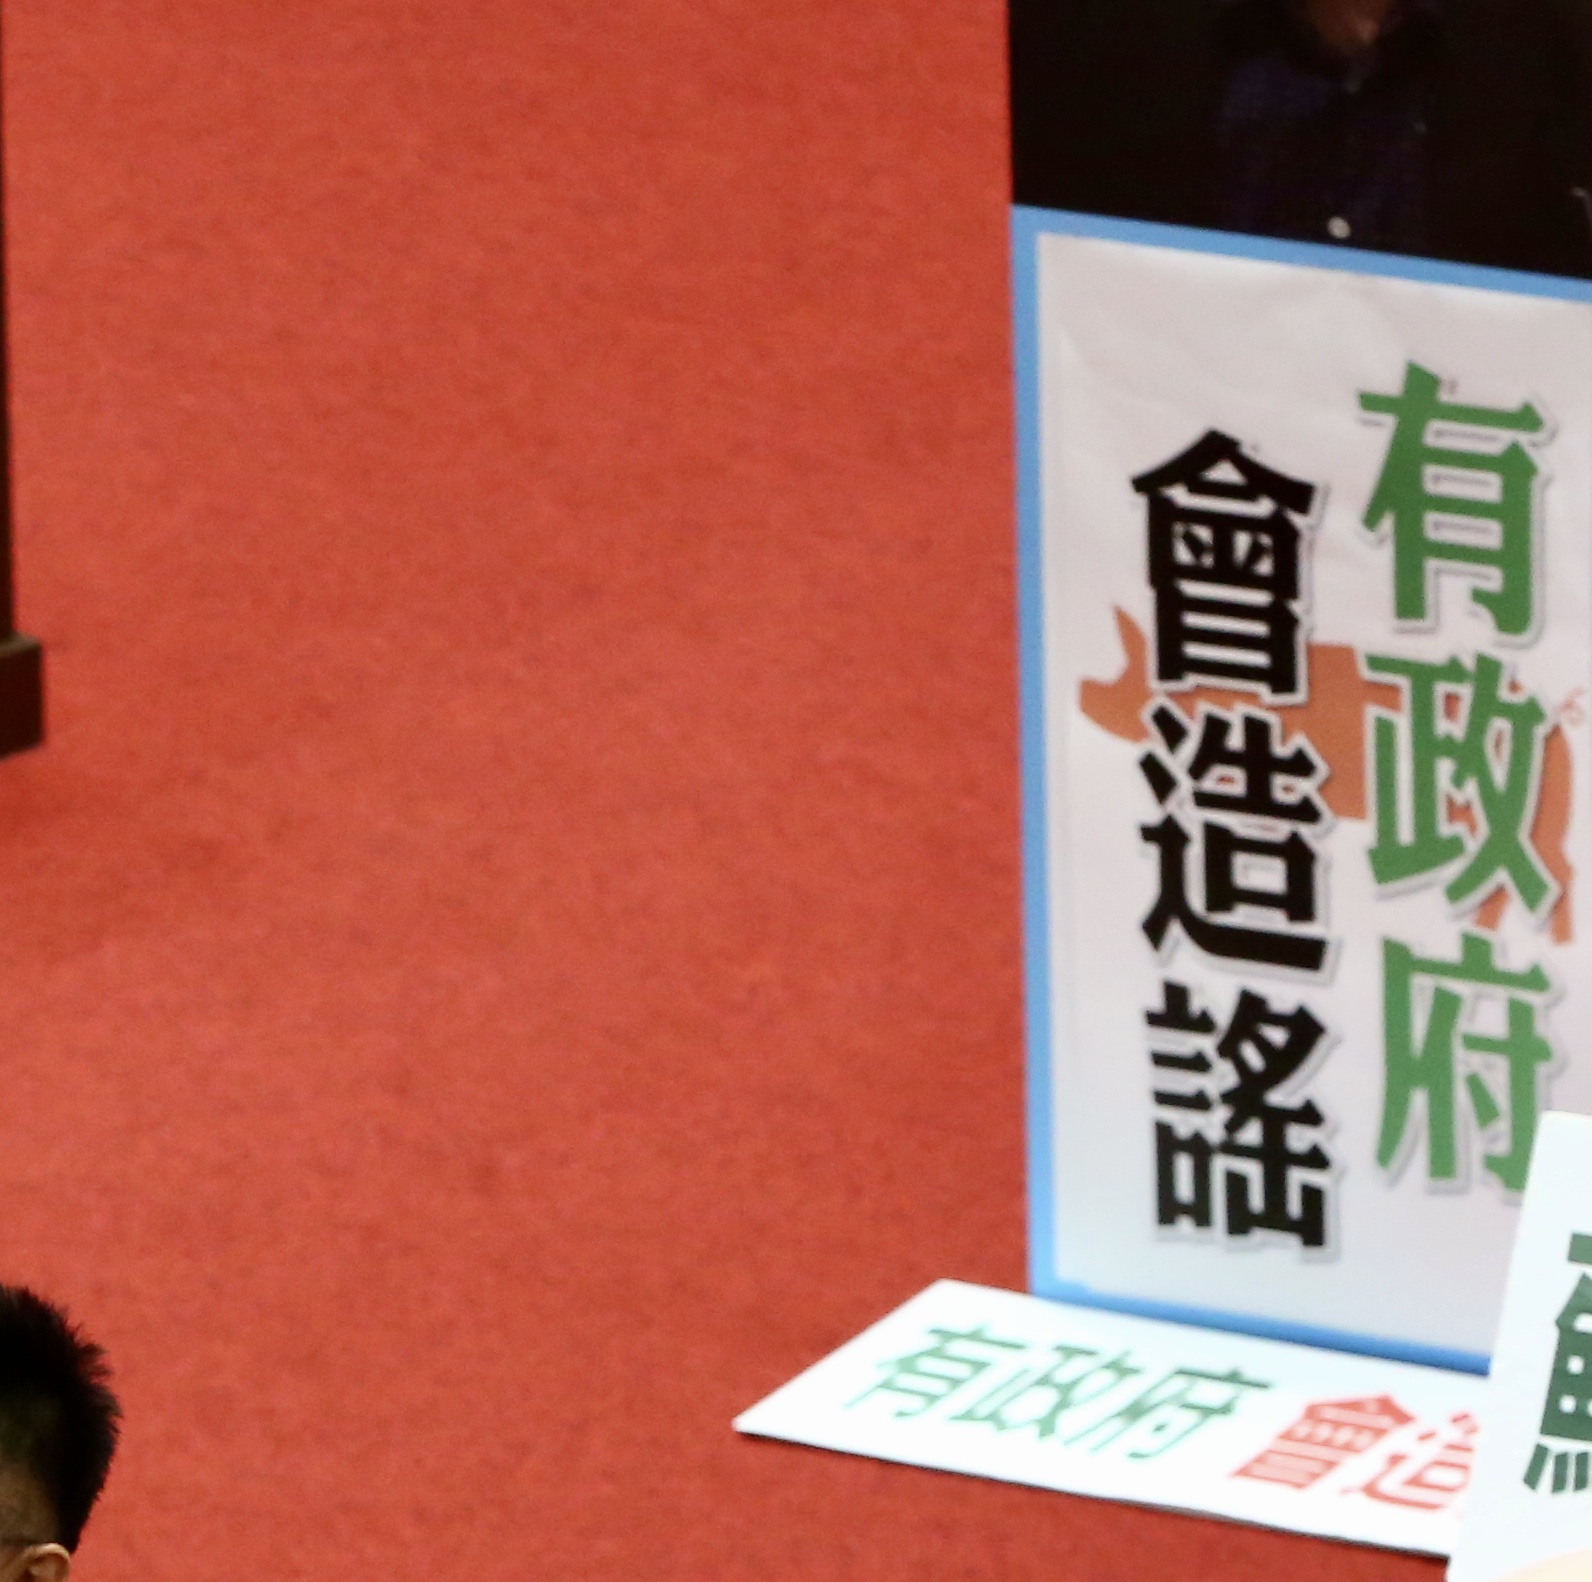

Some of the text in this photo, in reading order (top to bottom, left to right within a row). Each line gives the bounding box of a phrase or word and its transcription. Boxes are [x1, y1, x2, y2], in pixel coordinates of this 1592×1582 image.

[1131, 427, 1329, 1249] 會造謠
[1356, 359, 1554, 1192] 有政府
[844, 1323, 1275, 1461] 有政府
